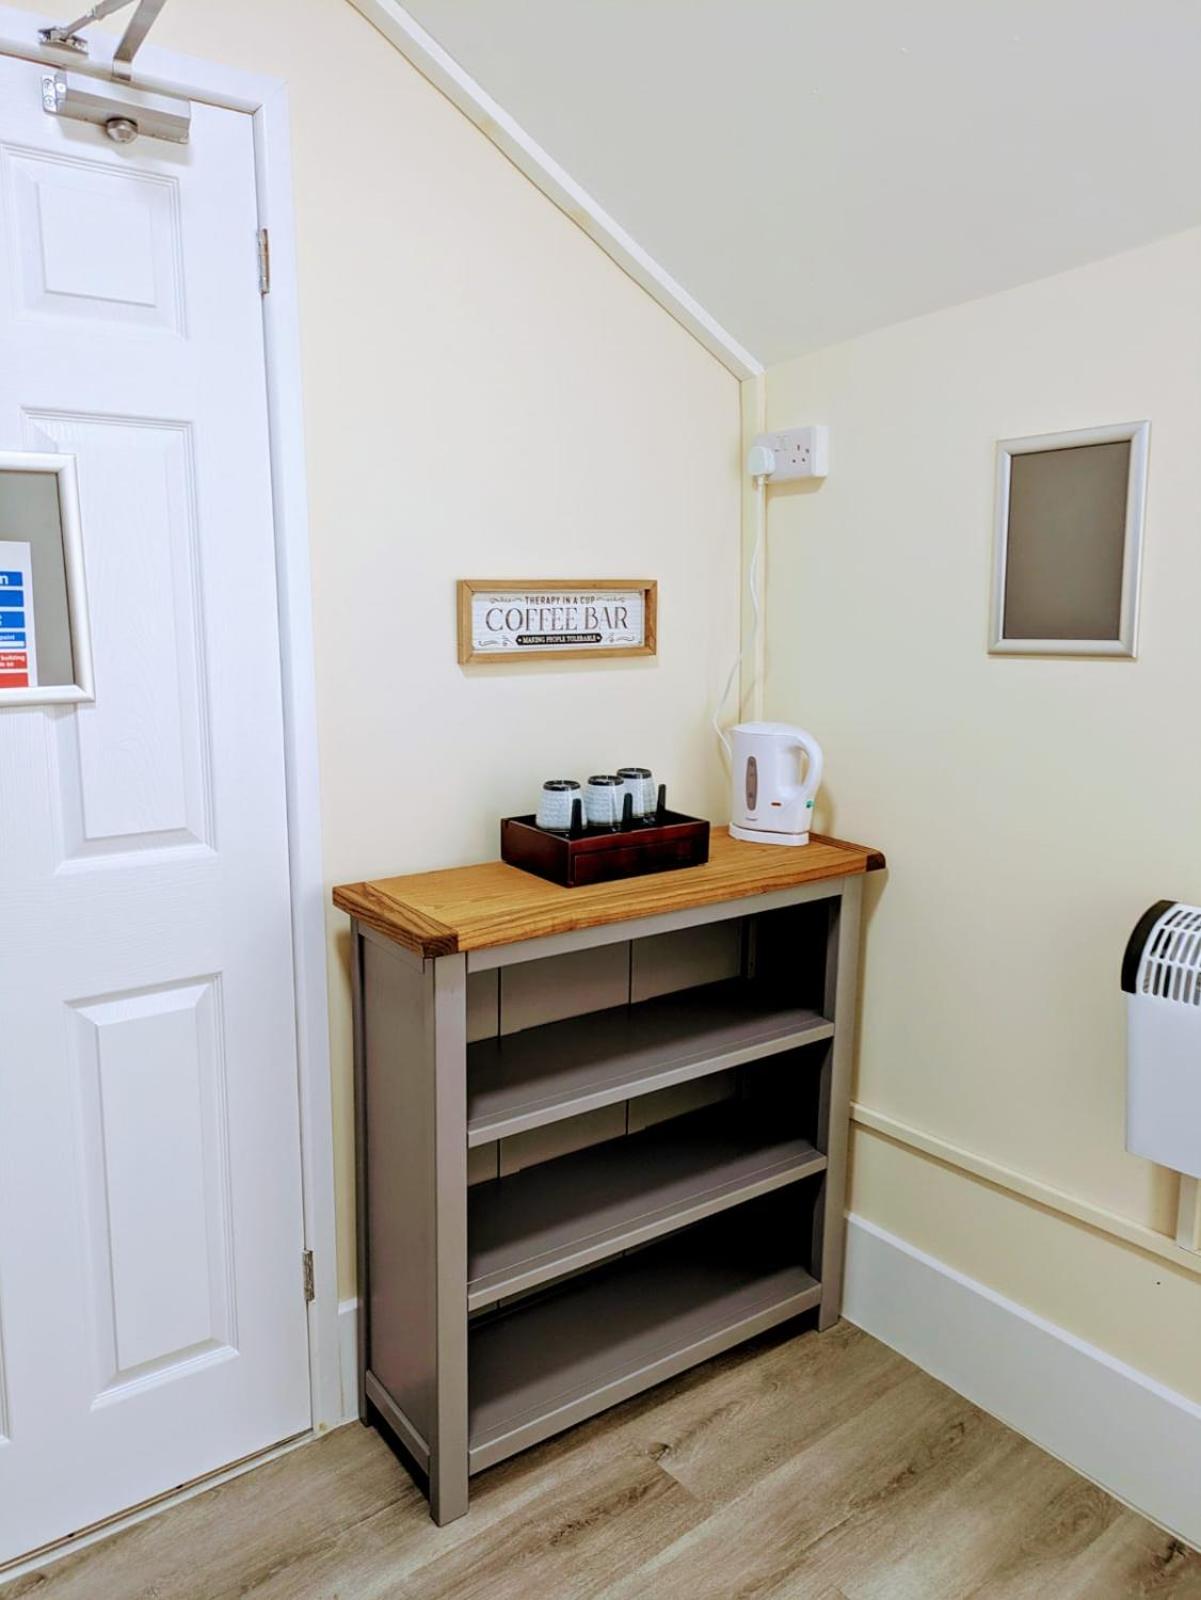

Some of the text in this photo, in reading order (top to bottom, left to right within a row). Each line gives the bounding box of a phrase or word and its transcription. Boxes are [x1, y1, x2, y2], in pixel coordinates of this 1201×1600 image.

[525, 596, 560, 604] THERAPY
[573, 596, 578, 604] A
[581, 596, 595, 604] CUP
[485, 606, 628, 632] COFFEE BAR
[546, 635, 565, 643] PEOPLE
